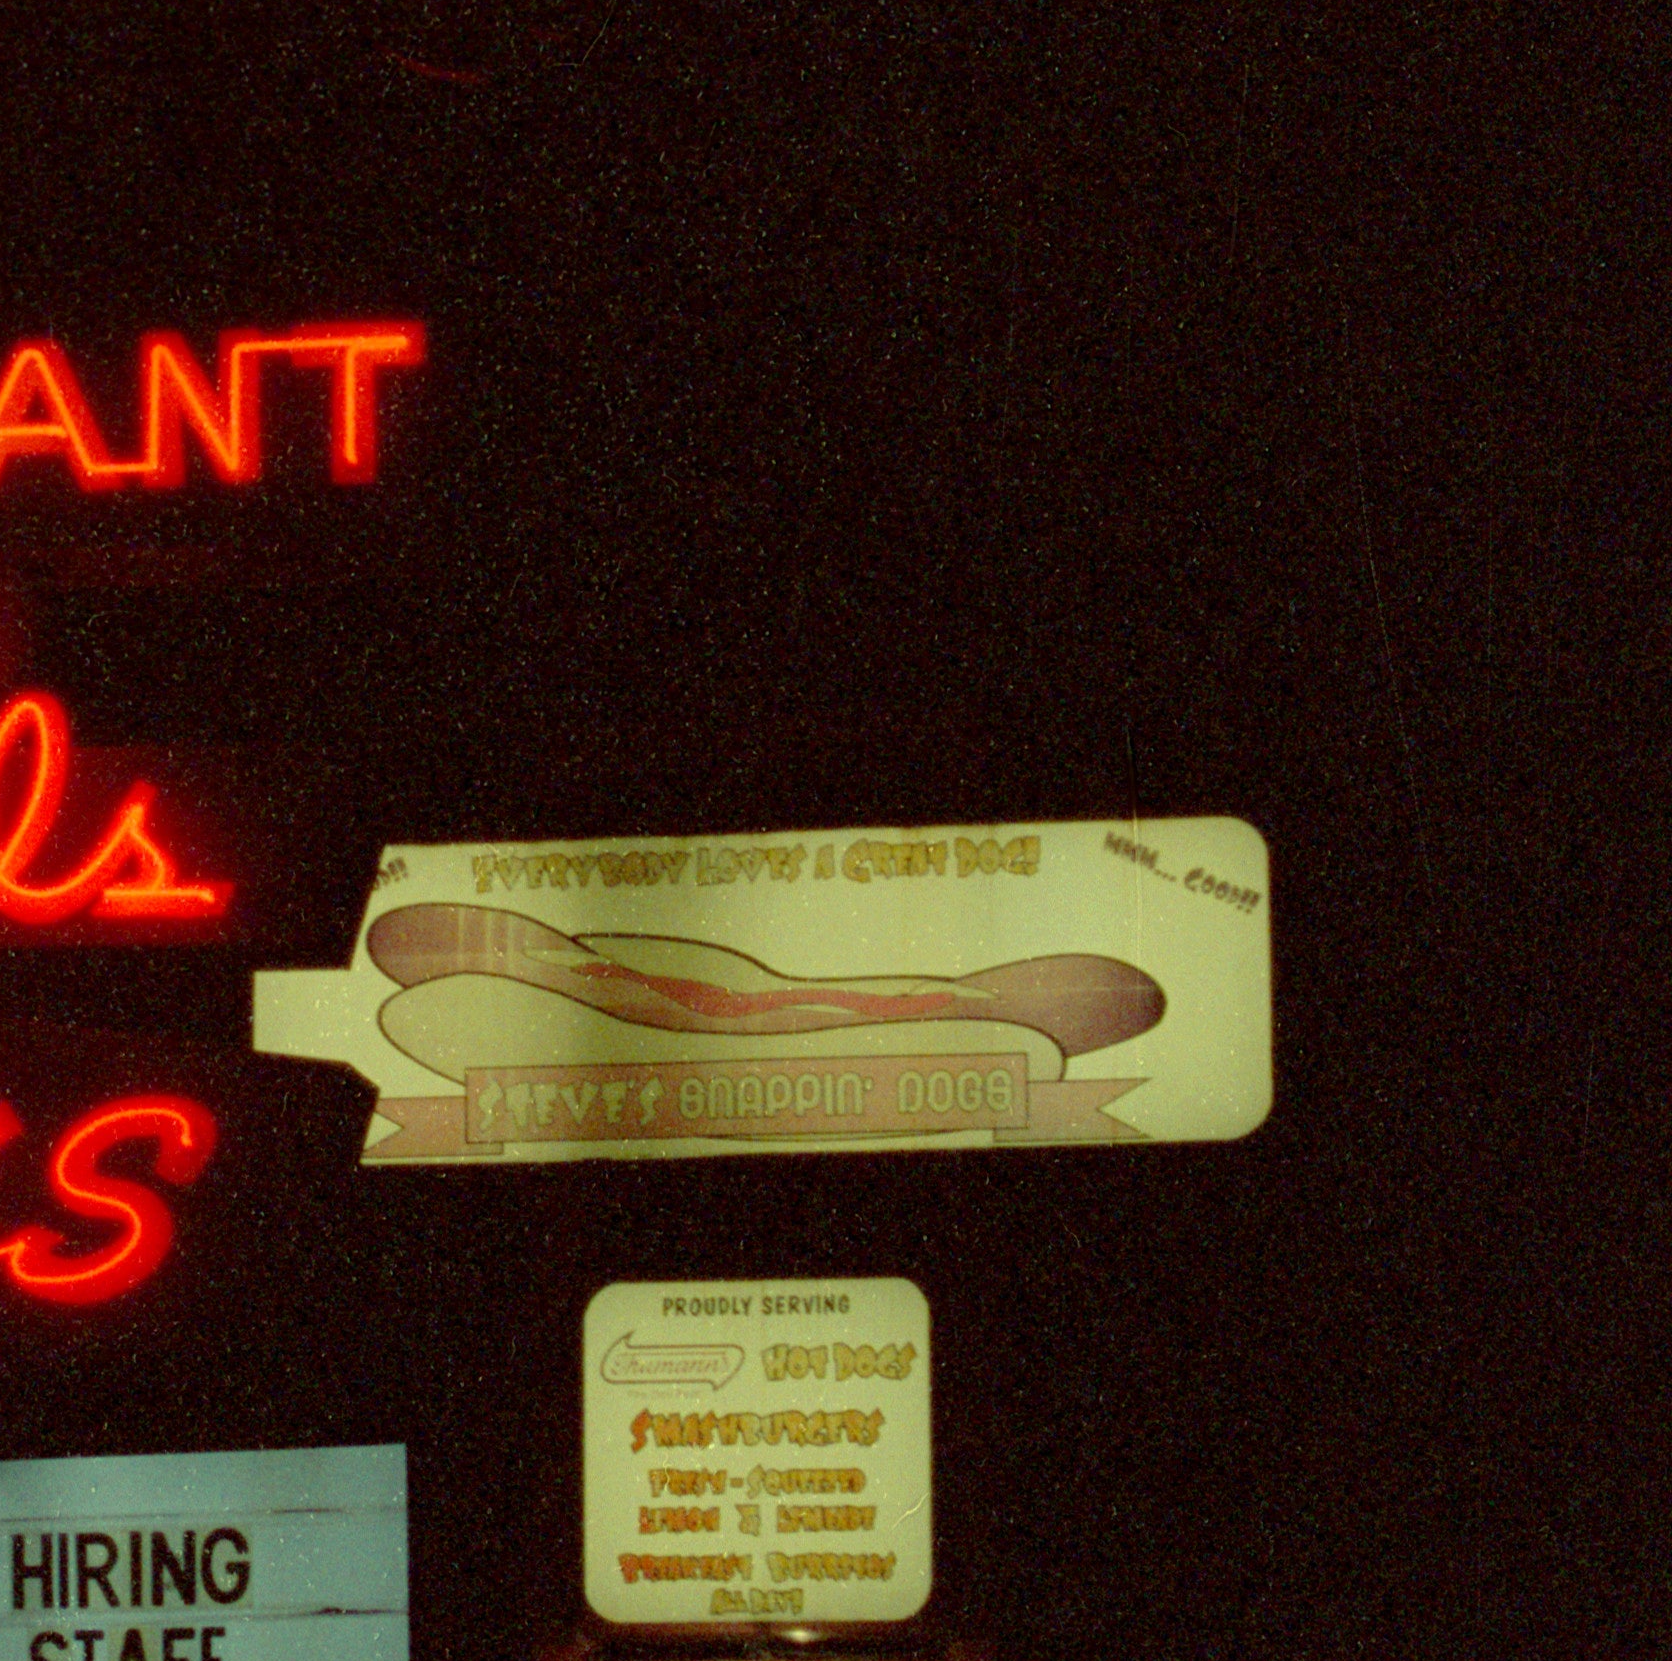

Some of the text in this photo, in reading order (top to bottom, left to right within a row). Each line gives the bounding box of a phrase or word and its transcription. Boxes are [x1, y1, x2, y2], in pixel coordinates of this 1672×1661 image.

[471, 836, 1042, 894] EVERYBODY LOVES A GREAT DOG!
[475, 1067, 1013, 1131] STEVE'S SNAPPIN' DOGS
[661, 1294, 852, 1318] PROUDLY SERVING
[761, 1342, 829, 1382] HOT
[832, 1341, 918, 1382] DOGS
[11, 1527, 252, 1610] HIRING
